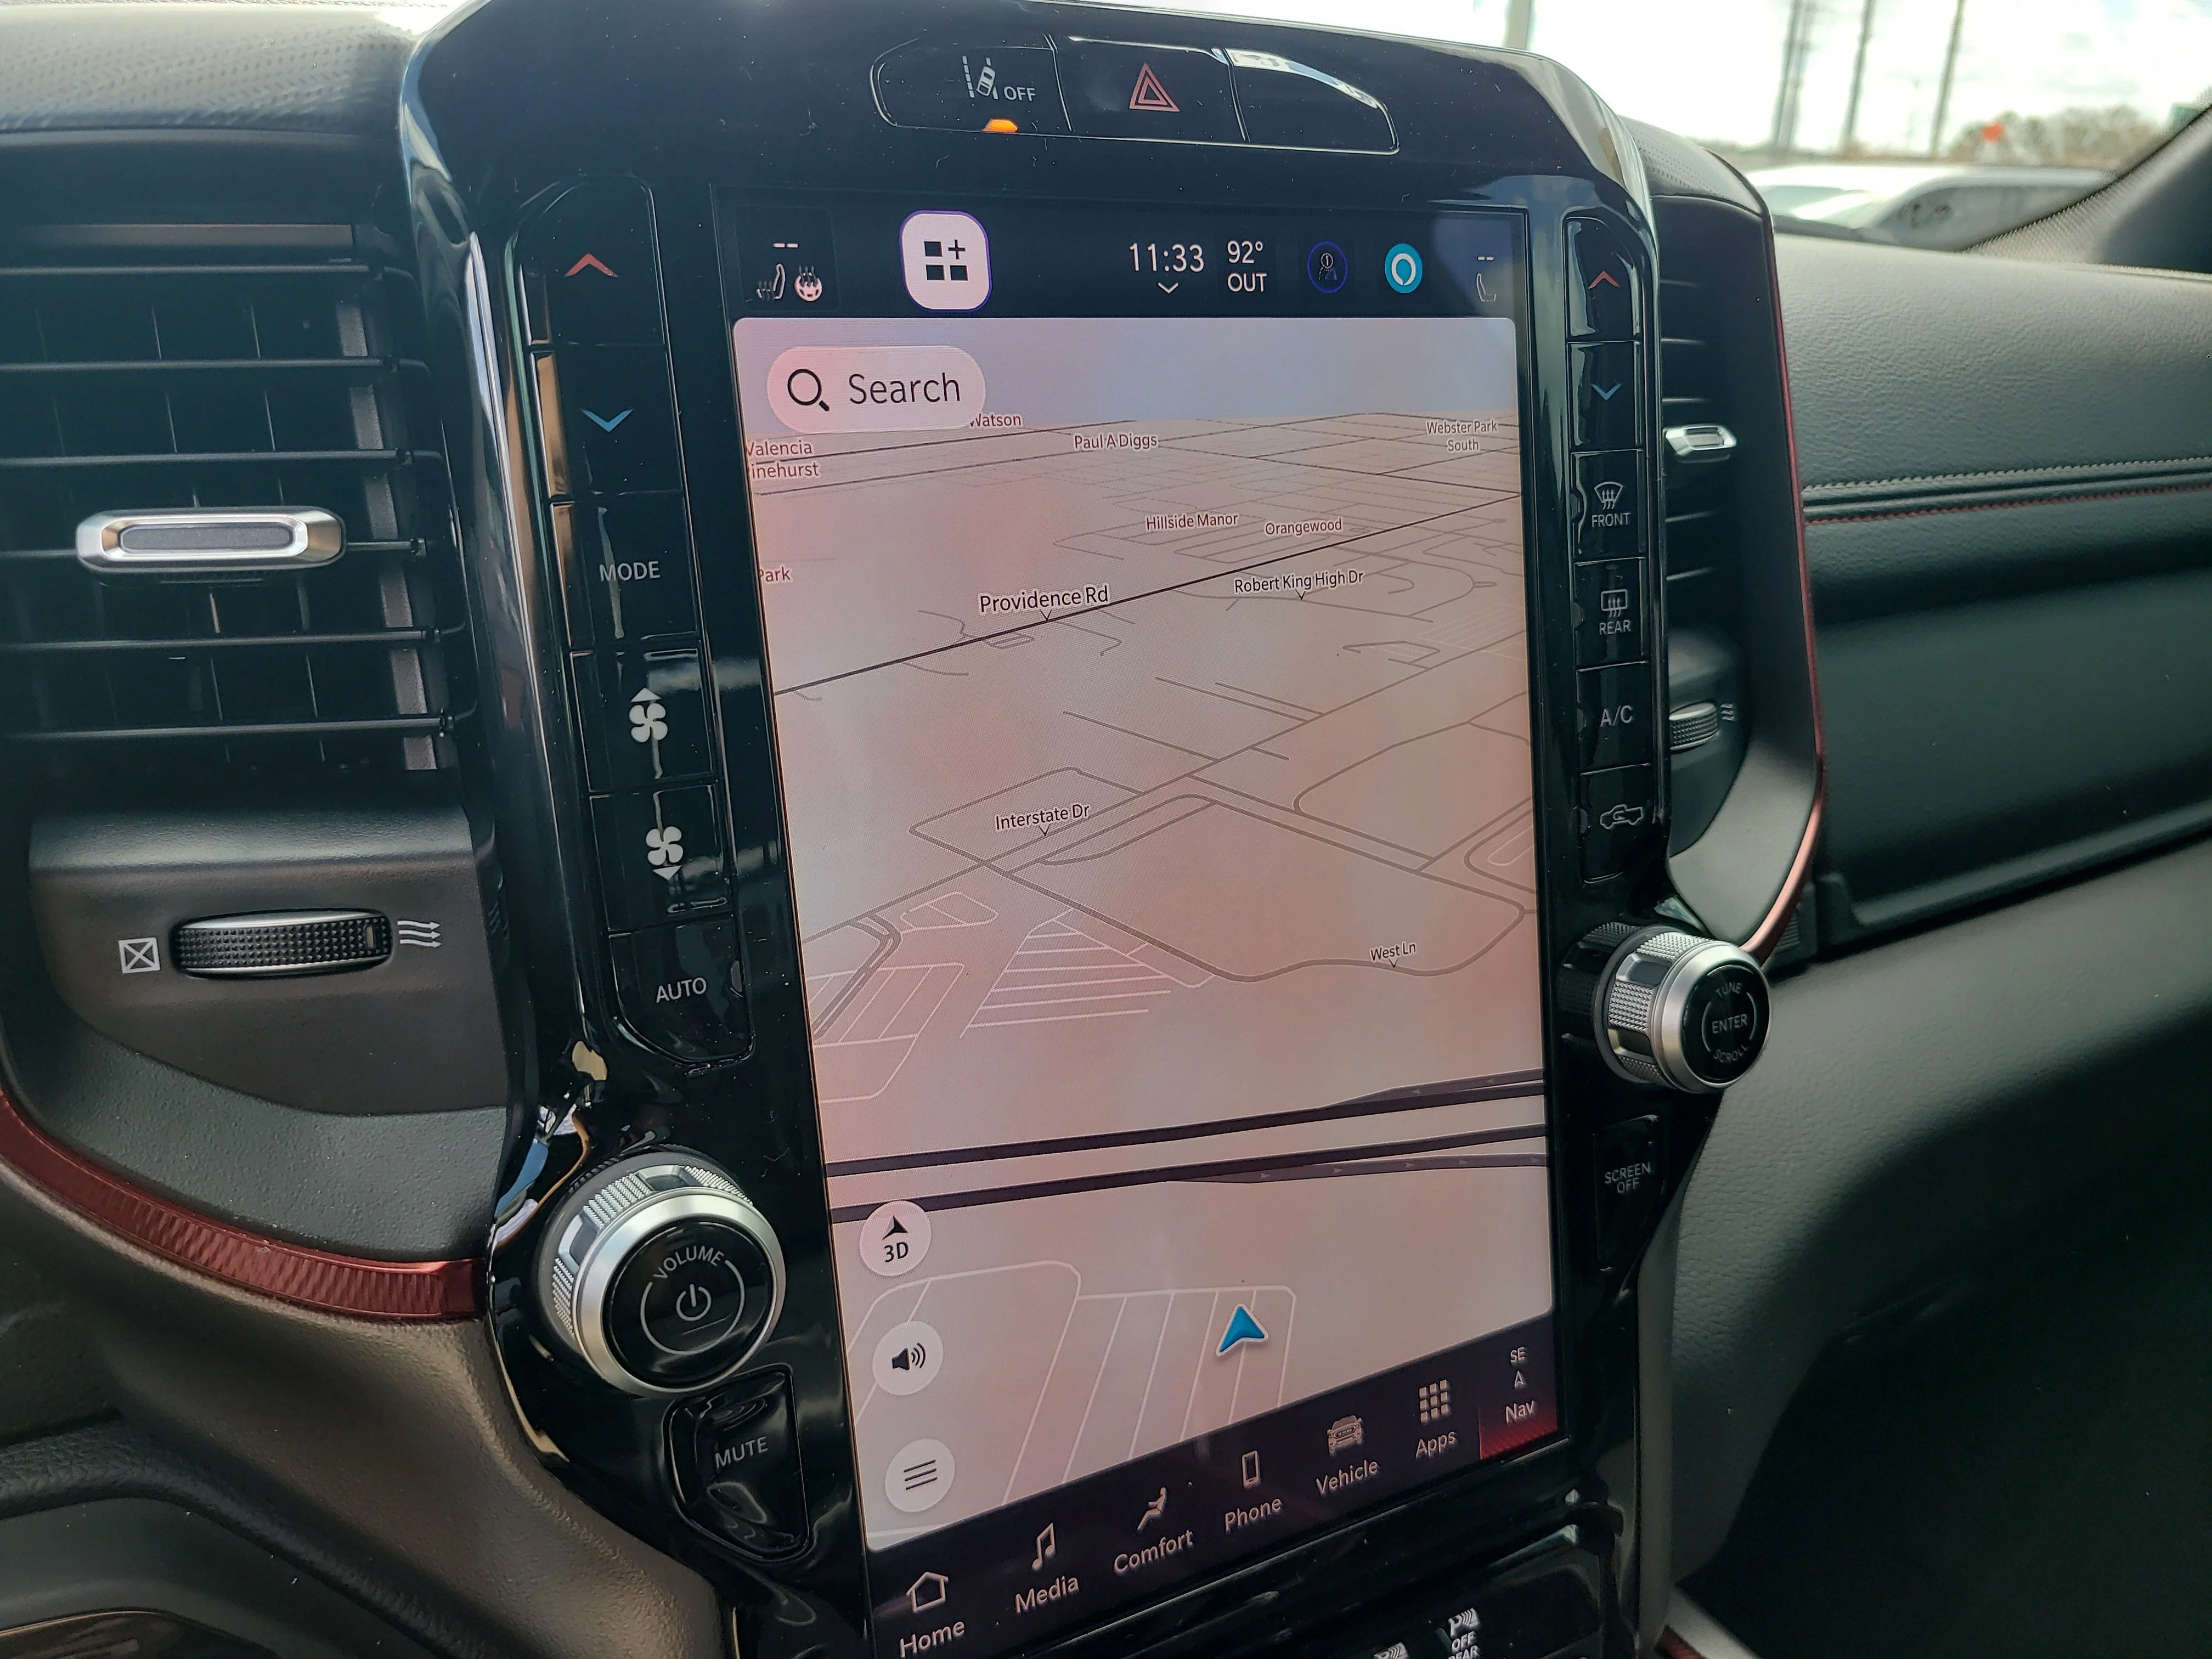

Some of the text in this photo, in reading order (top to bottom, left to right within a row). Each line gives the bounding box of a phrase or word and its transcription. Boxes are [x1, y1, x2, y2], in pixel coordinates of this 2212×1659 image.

[1003, 86, 1036, 101] OFF
[1129, 242, 1205, 273] 11:33
[1227, 240, 1263, 264] 92°
[1227, 272, 1267, 292] OUT
[848, 372, 961, 405] Search
[1426, 419, 1498, 435] Webster Park
[747, 439, 813, 456] Valencia
[1074, 433, 1157, 450] Paul A Diggs
[1447, 438, 1480, 452] South
[750, 462, 820, 479] inehurst
[1146, 512, 1239, 531] Hillside Manor
[1265, 518, 1343, 535] Orangewood
[1592, 512, 1632, 527] FRONT
[599, 561, 661, 582] MODE
[1234, 570, 1364, 594] Robert King High Dr
[980, 585, 1109, 613] Providence Rd
[1599, 620, 1631, 635] REAR
[1600, 705, 1633, 726] A/C
[995, 804, 1090, 830] Interstate Dr
[1370, 943, 1416, 961] West Ln
[655, 977, 708, 1003] AUTO
[1715, 981, 1742, 998] TUNE
[1712, 1014, 1748, 1034] ENTER
[1713, 1045, 1749, 1063] SCROLL
[1604, 1161, 1651, 1184] SCREEN
[1617, 1177, 1640, 1194] OFF
[653, 1246, 725, 1280] VOLUME
[884, 1242, 909, 1263] 3D
[1510, 1346, 1527, 1365] SE
[1505, 1400, 1536, 1425] Nav
[714, 1436, 768, 1469] MUTE
[1415, 1430, 1457, 1459] Apps
[1316, 1459, 1379, 1496] Vehicle
[1224, 1498, 1283, 1533] Phone
[1113, 1529, 1194, 1576] Comfort
[1014, 1575, 1080, 1614] Media
[899, 1621, 966, 1659] Home
[1452, 1630, 1476, 1652] OFF
